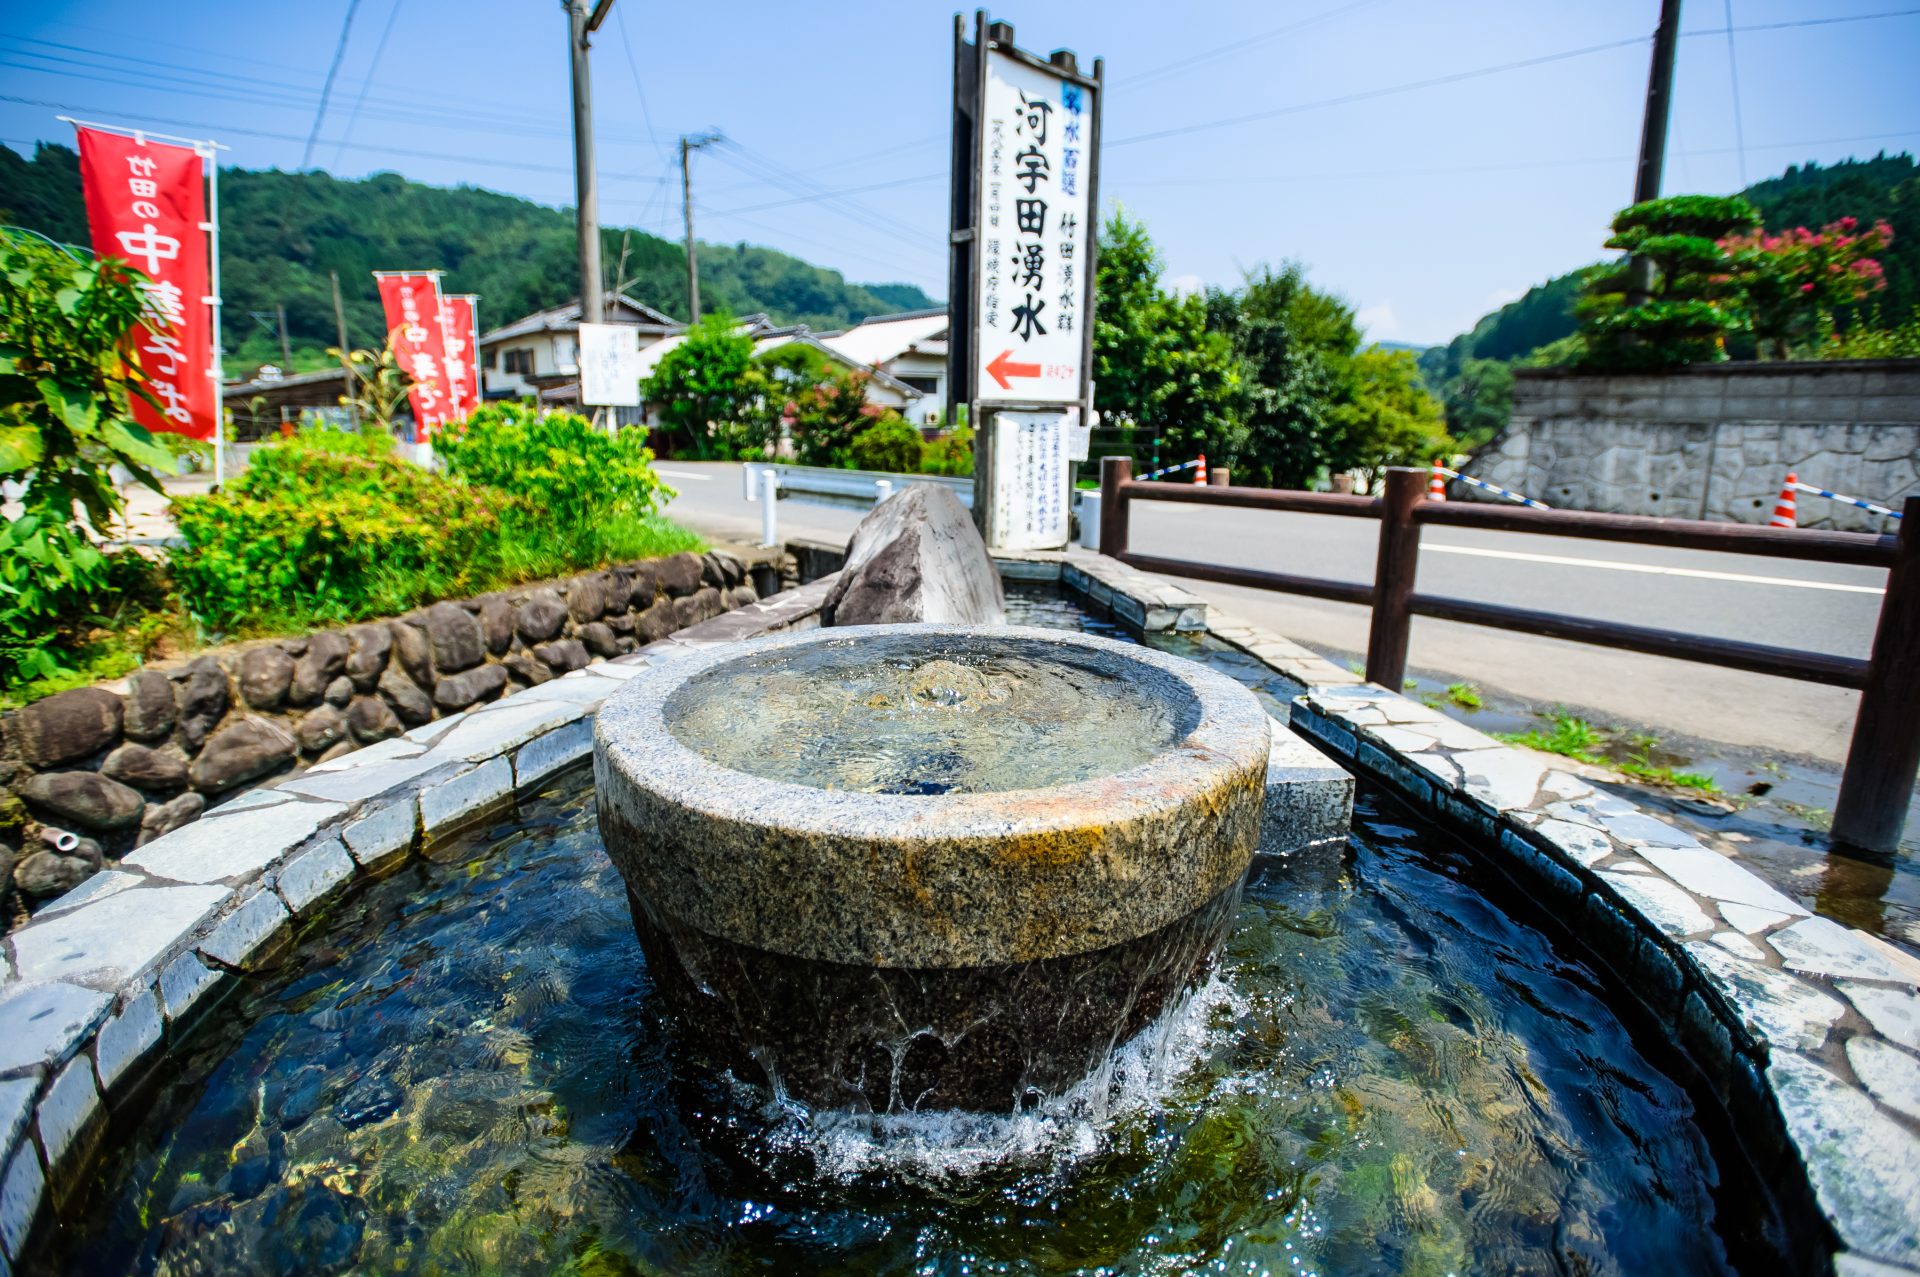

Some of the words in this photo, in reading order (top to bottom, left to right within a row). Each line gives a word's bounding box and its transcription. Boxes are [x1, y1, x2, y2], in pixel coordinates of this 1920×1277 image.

[1010, 88, 1053, 343] 河宇田湧水
[1057, 212, 1079, 337] 竹田湧水群
